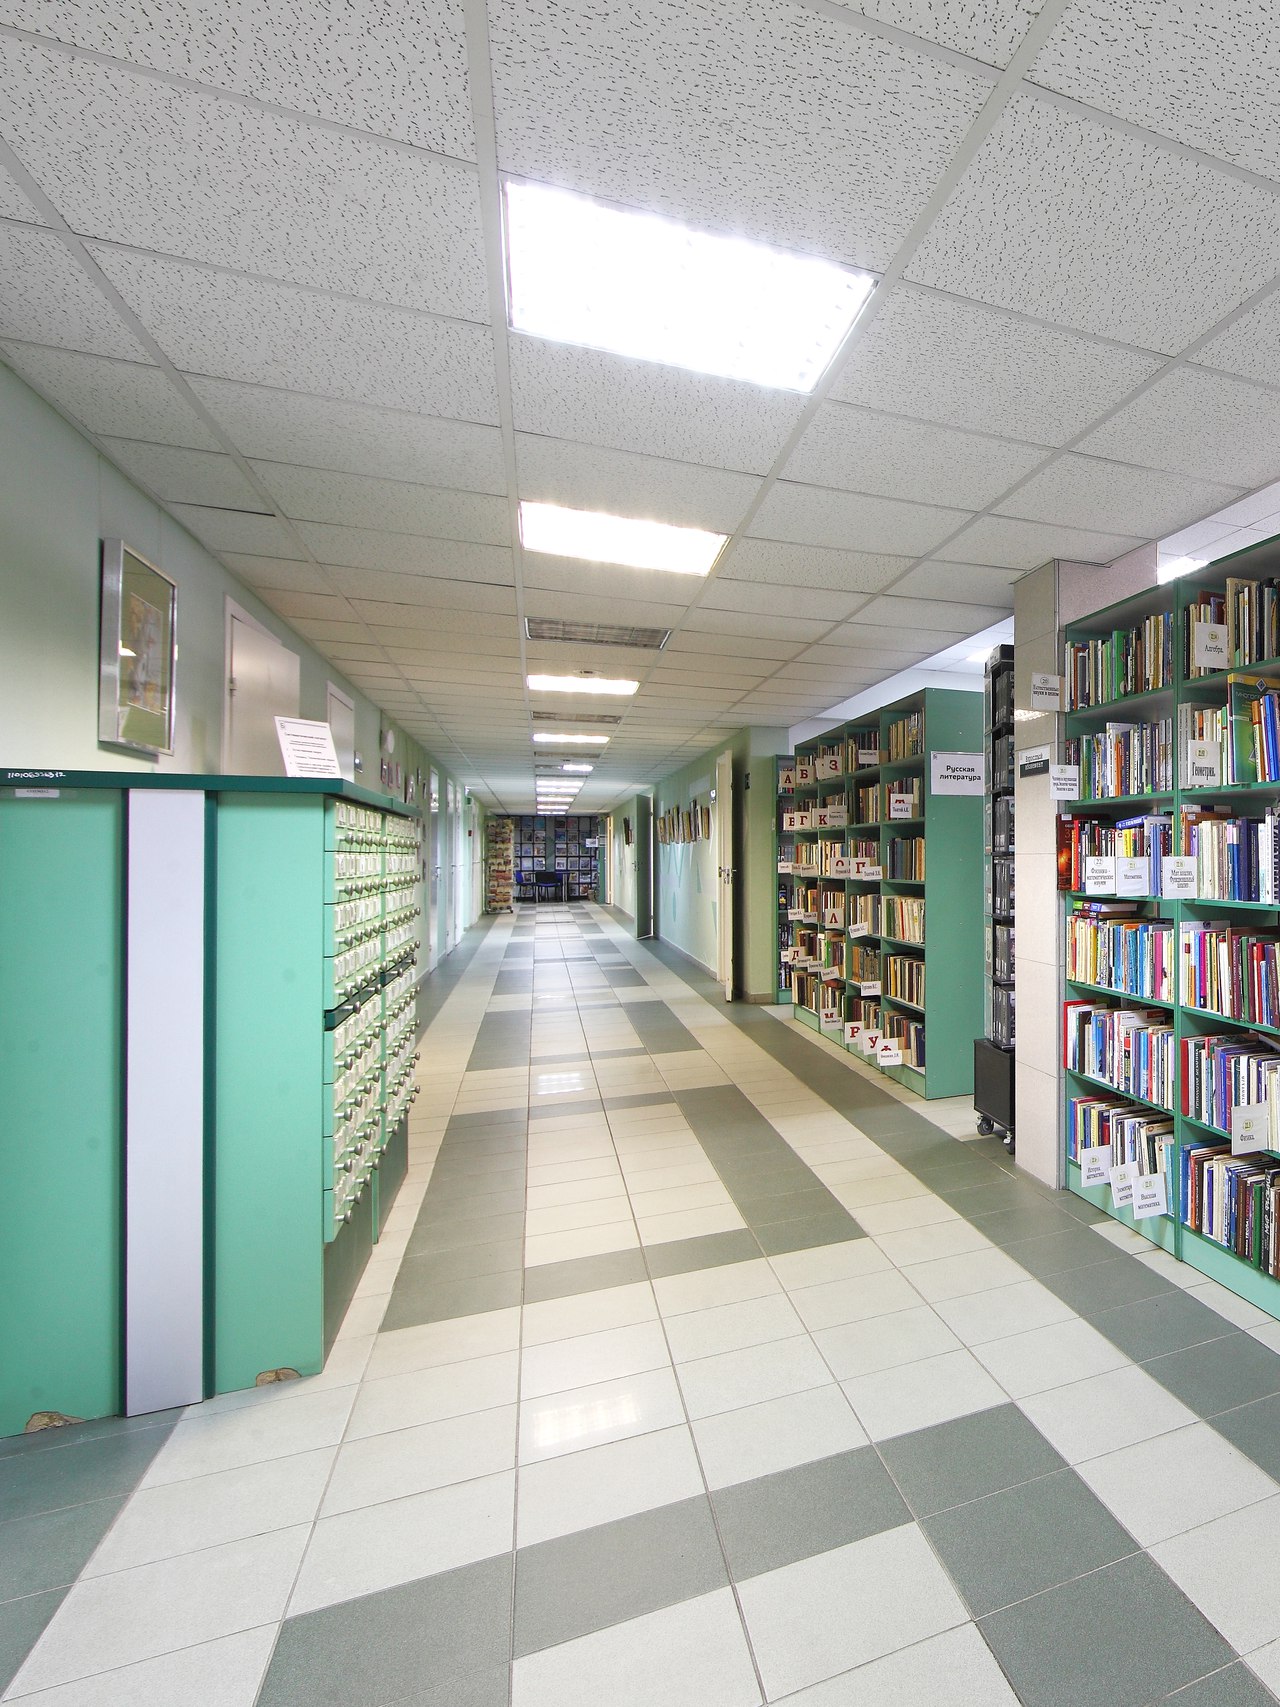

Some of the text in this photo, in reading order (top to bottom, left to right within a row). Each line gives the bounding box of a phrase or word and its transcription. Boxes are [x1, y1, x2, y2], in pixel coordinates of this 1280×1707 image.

[829, 760, 838, 770] З
[946, 765, 975, 774] Русская
[800, 769, 808, 779] Б
[1192, 762, 1216, 780] Геометрия.
[784, 774, 792, 784] А
[939, 773, 981, 782] литература
[800, 816, 808, 825] Г
[819, 815, 827, 825] К
[830, 913, 838, 924] Л
[850, 1027, 860, 1038] Р
[868, 1035, 879, 1048] У
[1239, 1134, 1255, 1142] Физика.
